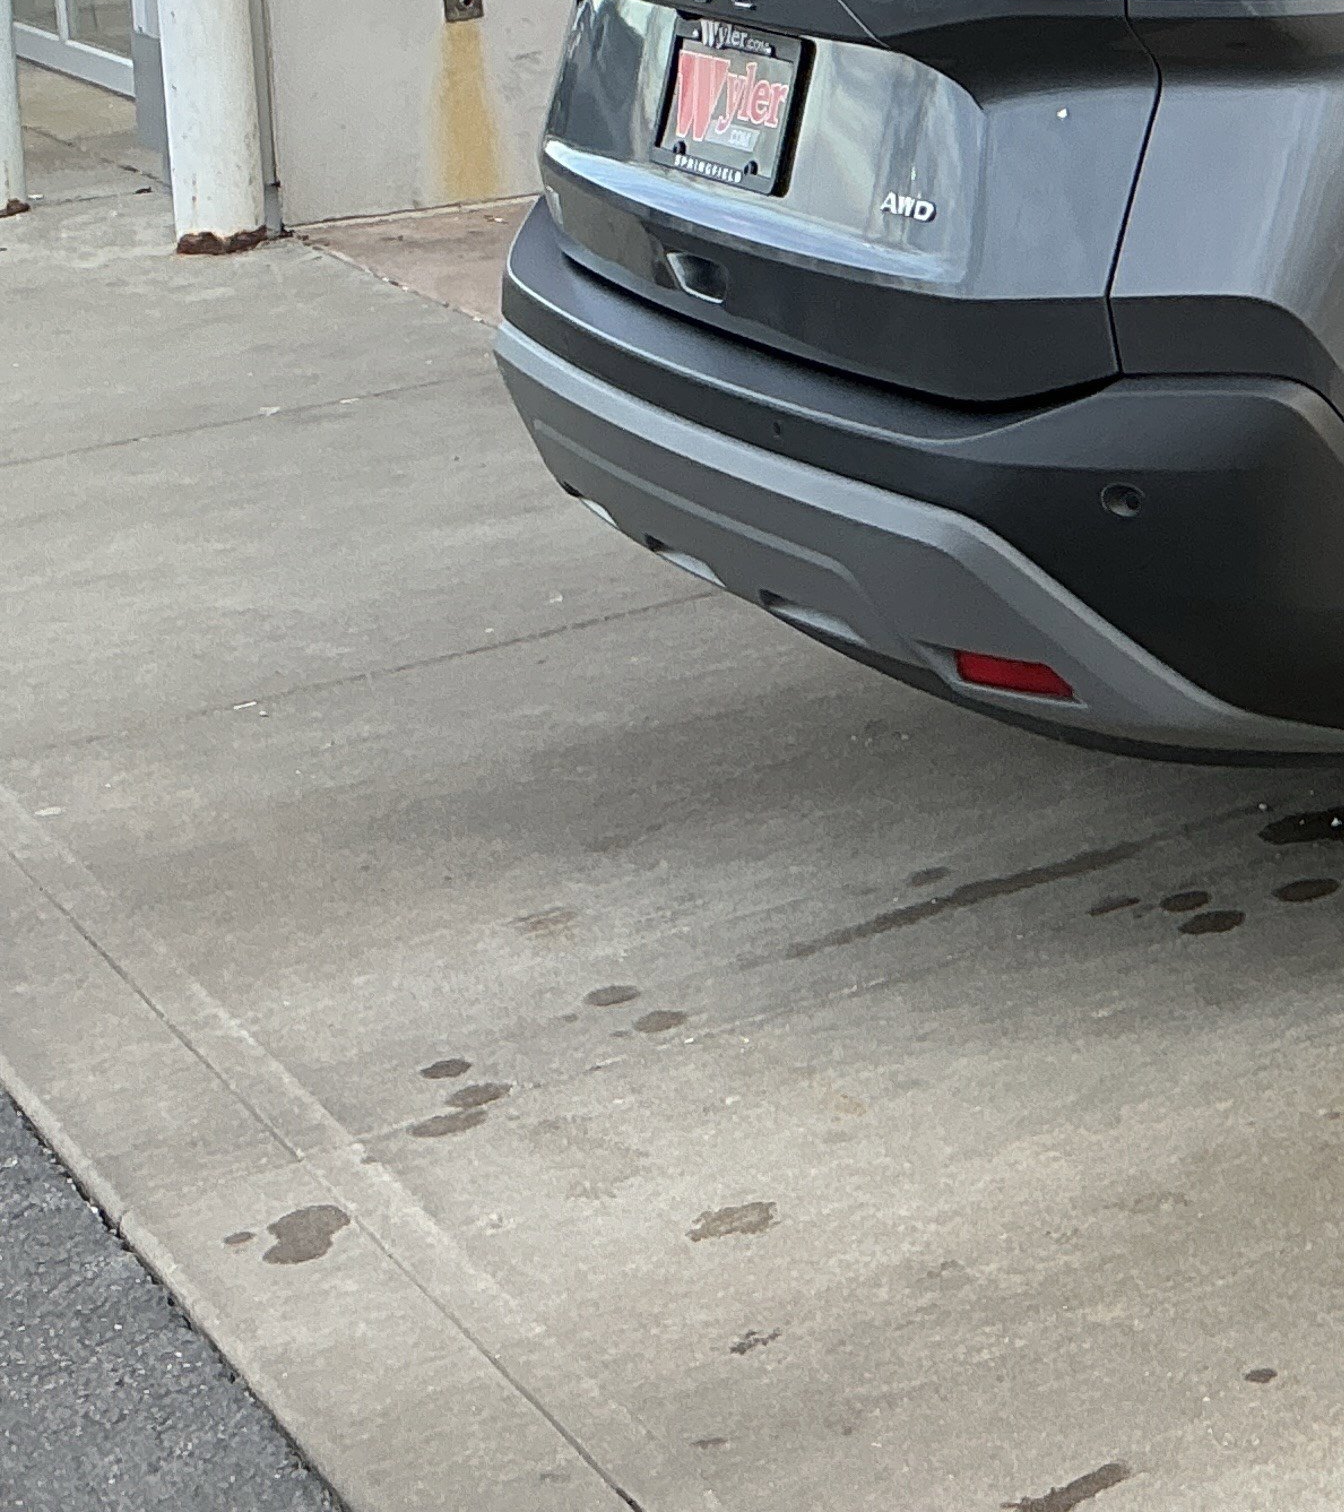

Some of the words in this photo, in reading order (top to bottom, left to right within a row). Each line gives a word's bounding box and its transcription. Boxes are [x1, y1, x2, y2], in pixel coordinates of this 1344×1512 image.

[676, 49, 789, 142] Wyler
[674, 154, 742, 183] SPRINGFIELD
[880, 191, 936, 222] AWD
